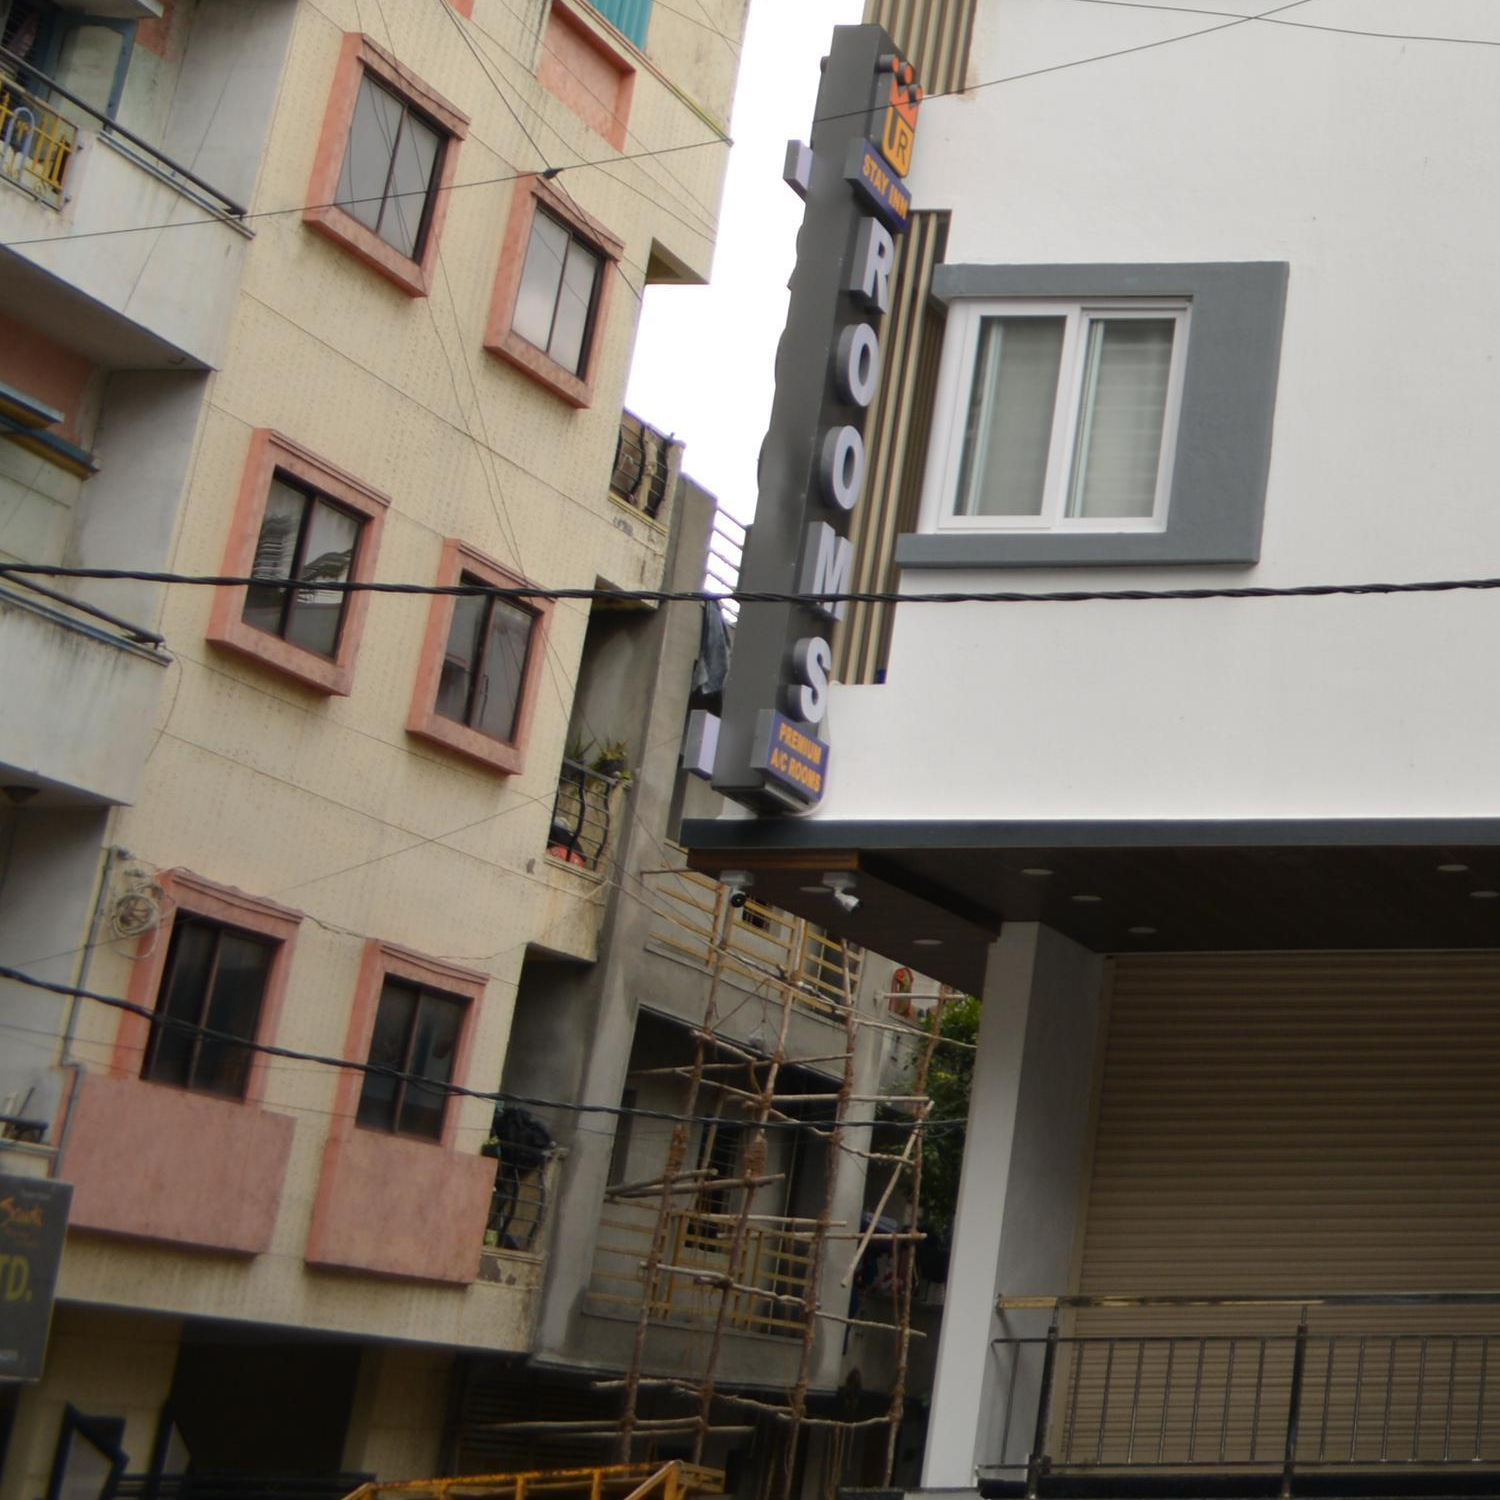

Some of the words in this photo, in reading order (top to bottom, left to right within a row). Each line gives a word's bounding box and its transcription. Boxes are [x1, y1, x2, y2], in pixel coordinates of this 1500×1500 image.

[863, 153, 889, 196] STAY
[889, 185, 908, 221] INN
[798, 216, 895, 724] ROOMS
[769, 747, 788, 772] A/C
[788, 756, 821, 793] ROOMS
[778, 722, 822, 765] PREMIUM
